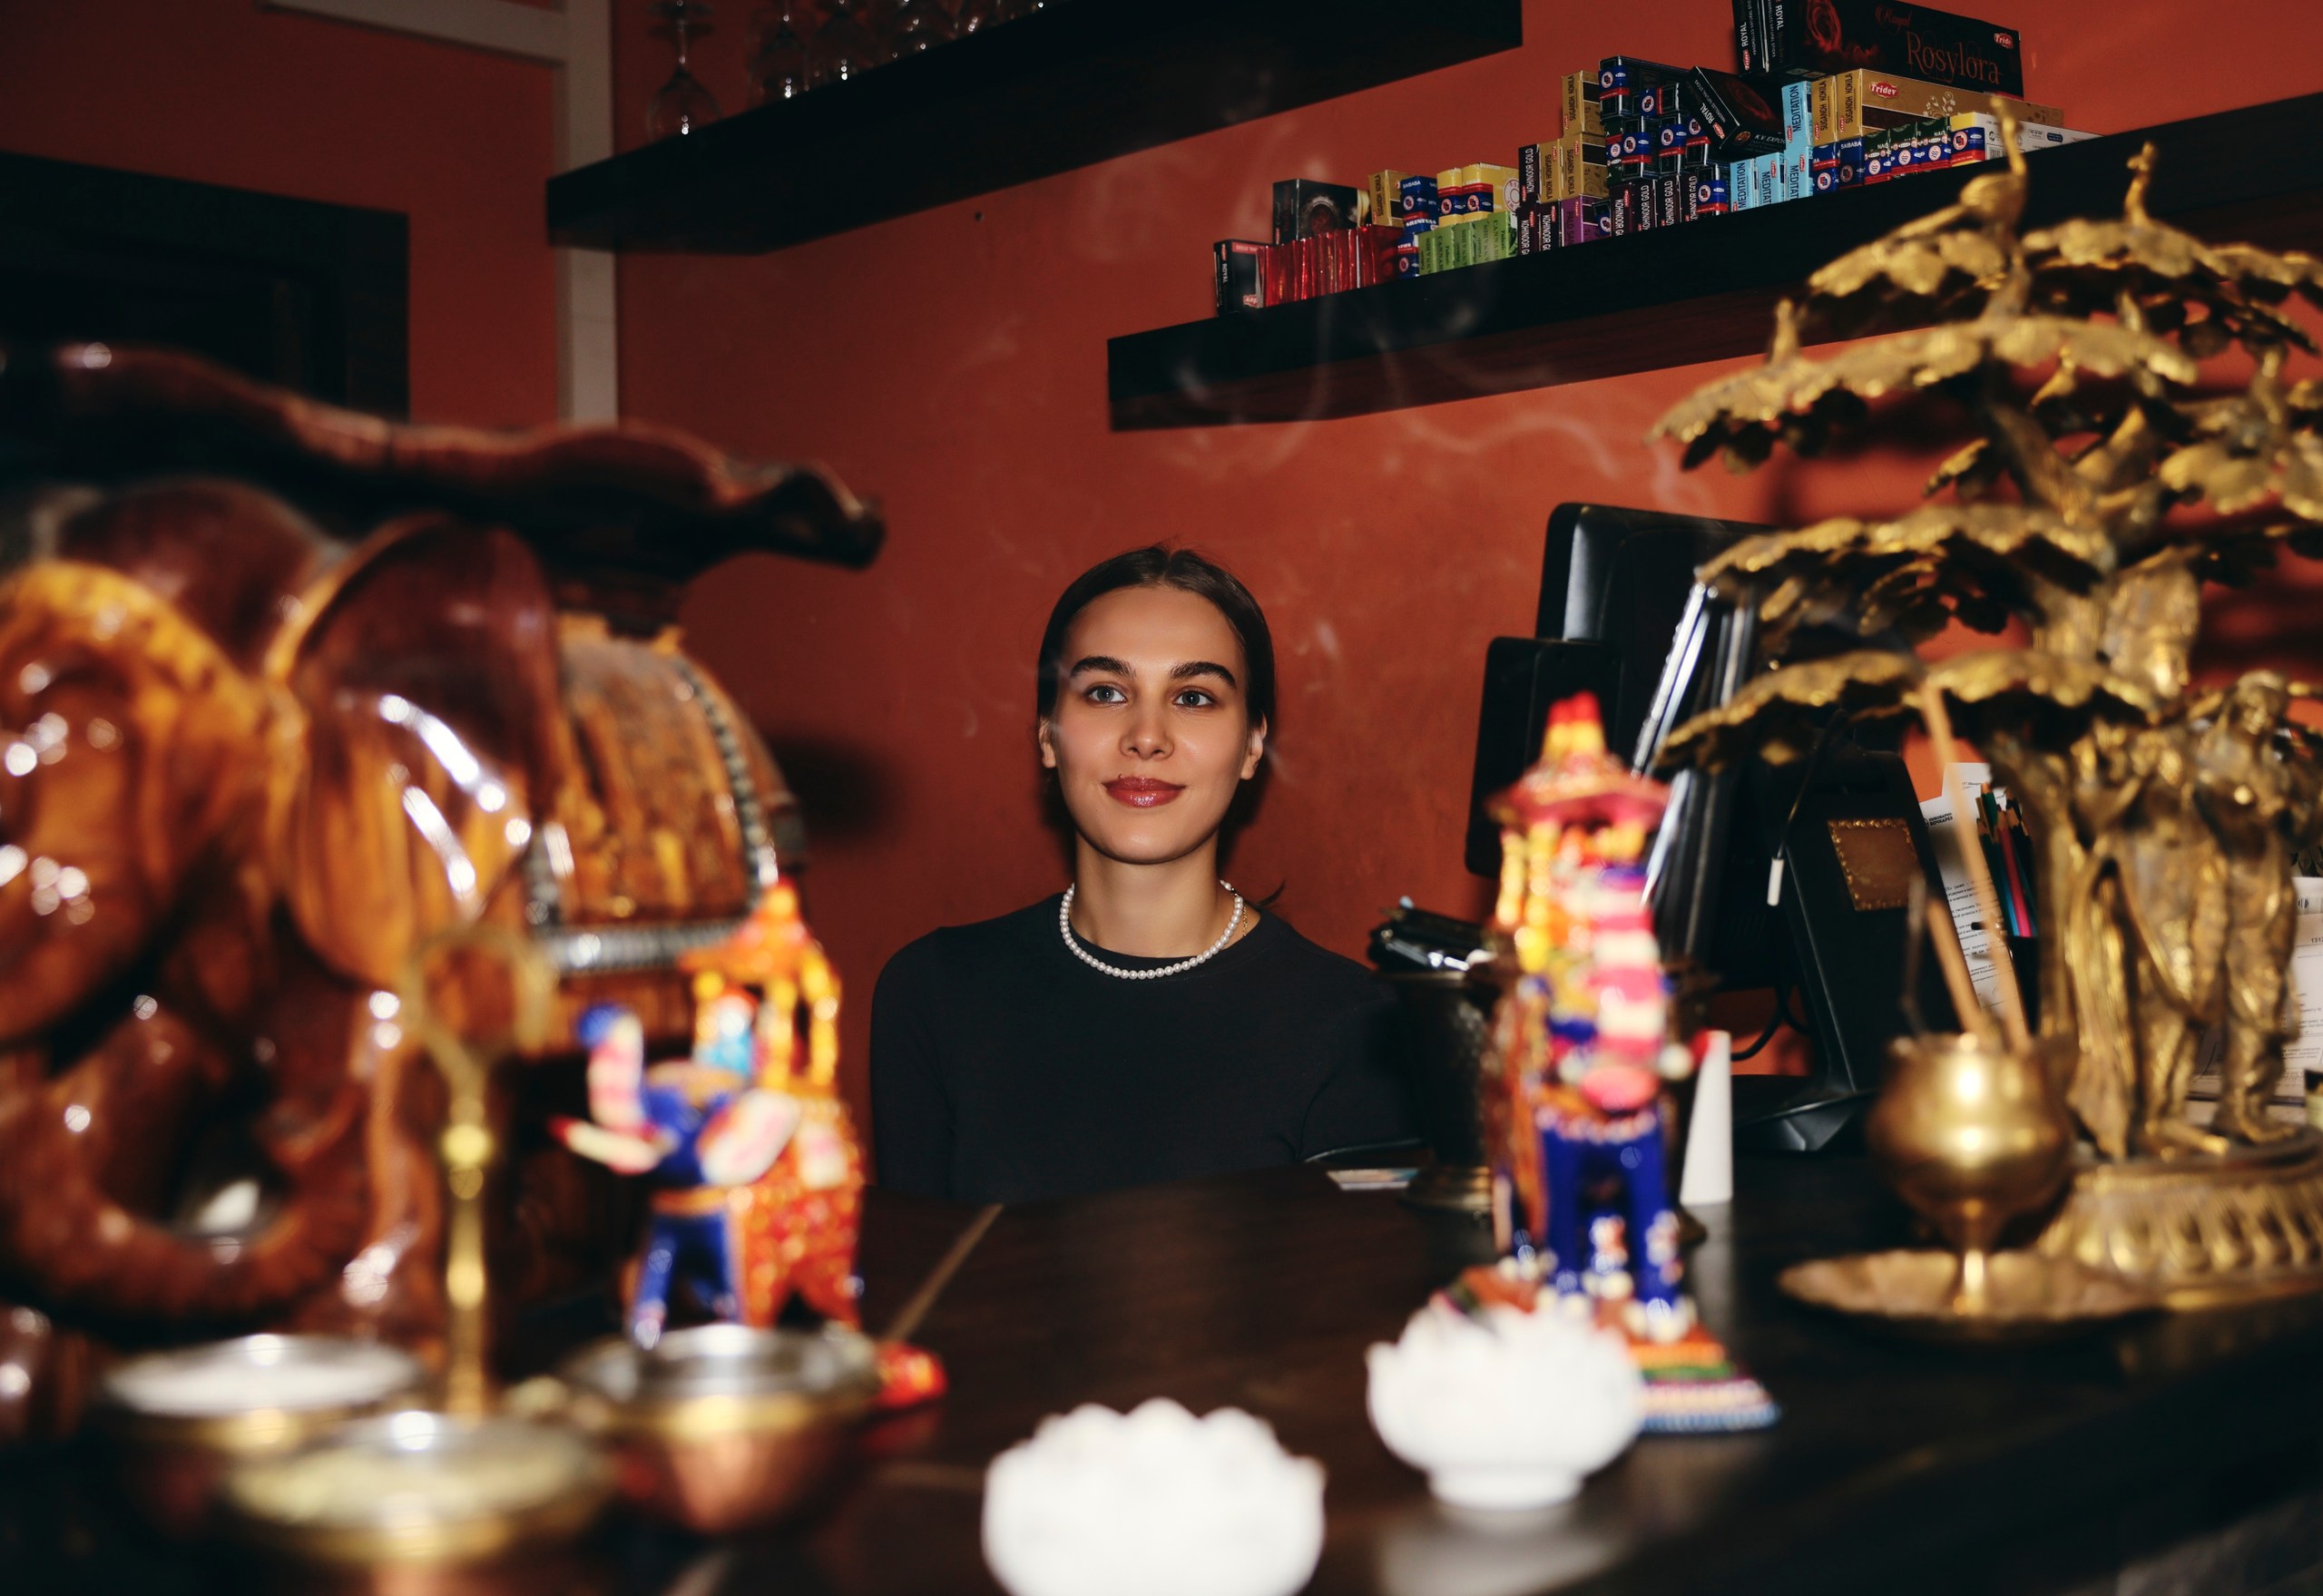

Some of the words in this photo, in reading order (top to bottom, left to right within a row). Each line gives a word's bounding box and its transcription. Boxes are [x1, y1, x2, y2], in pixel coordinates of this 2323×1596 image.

[1775, 5, 1784, 31] ROYAL
[1740, 22, 1749, 47] ROYAL
[1906, 30, 2002, 85] Rosylora
[1818, 81, 1827, 104] KOKILA
[1845, 73, 1853, 94] KOKILA
[1871, 83, 1897, 96] Tridev
[1700, 103, 1715, 124] ROYAL
[1789, 85, 1801, 132] MEDITATION
[1845, 97, 1853, 123] SUGANDH
[1524, 148, 1534, 166] GOLD
[1526, 167, 1534, 193] KOHINOOR
[1664, 180, 1673, 198] GOLD
[1737, 162, 1747, 208] MEDITATION
[1641, 185, 1649, 203] GOLD
[1615, 199, 1623, 227] KOHINOOR
[1521, 220, 1529, 247] KOHINOOR
[1542, 214, 1550, 241] KOHINOOR
